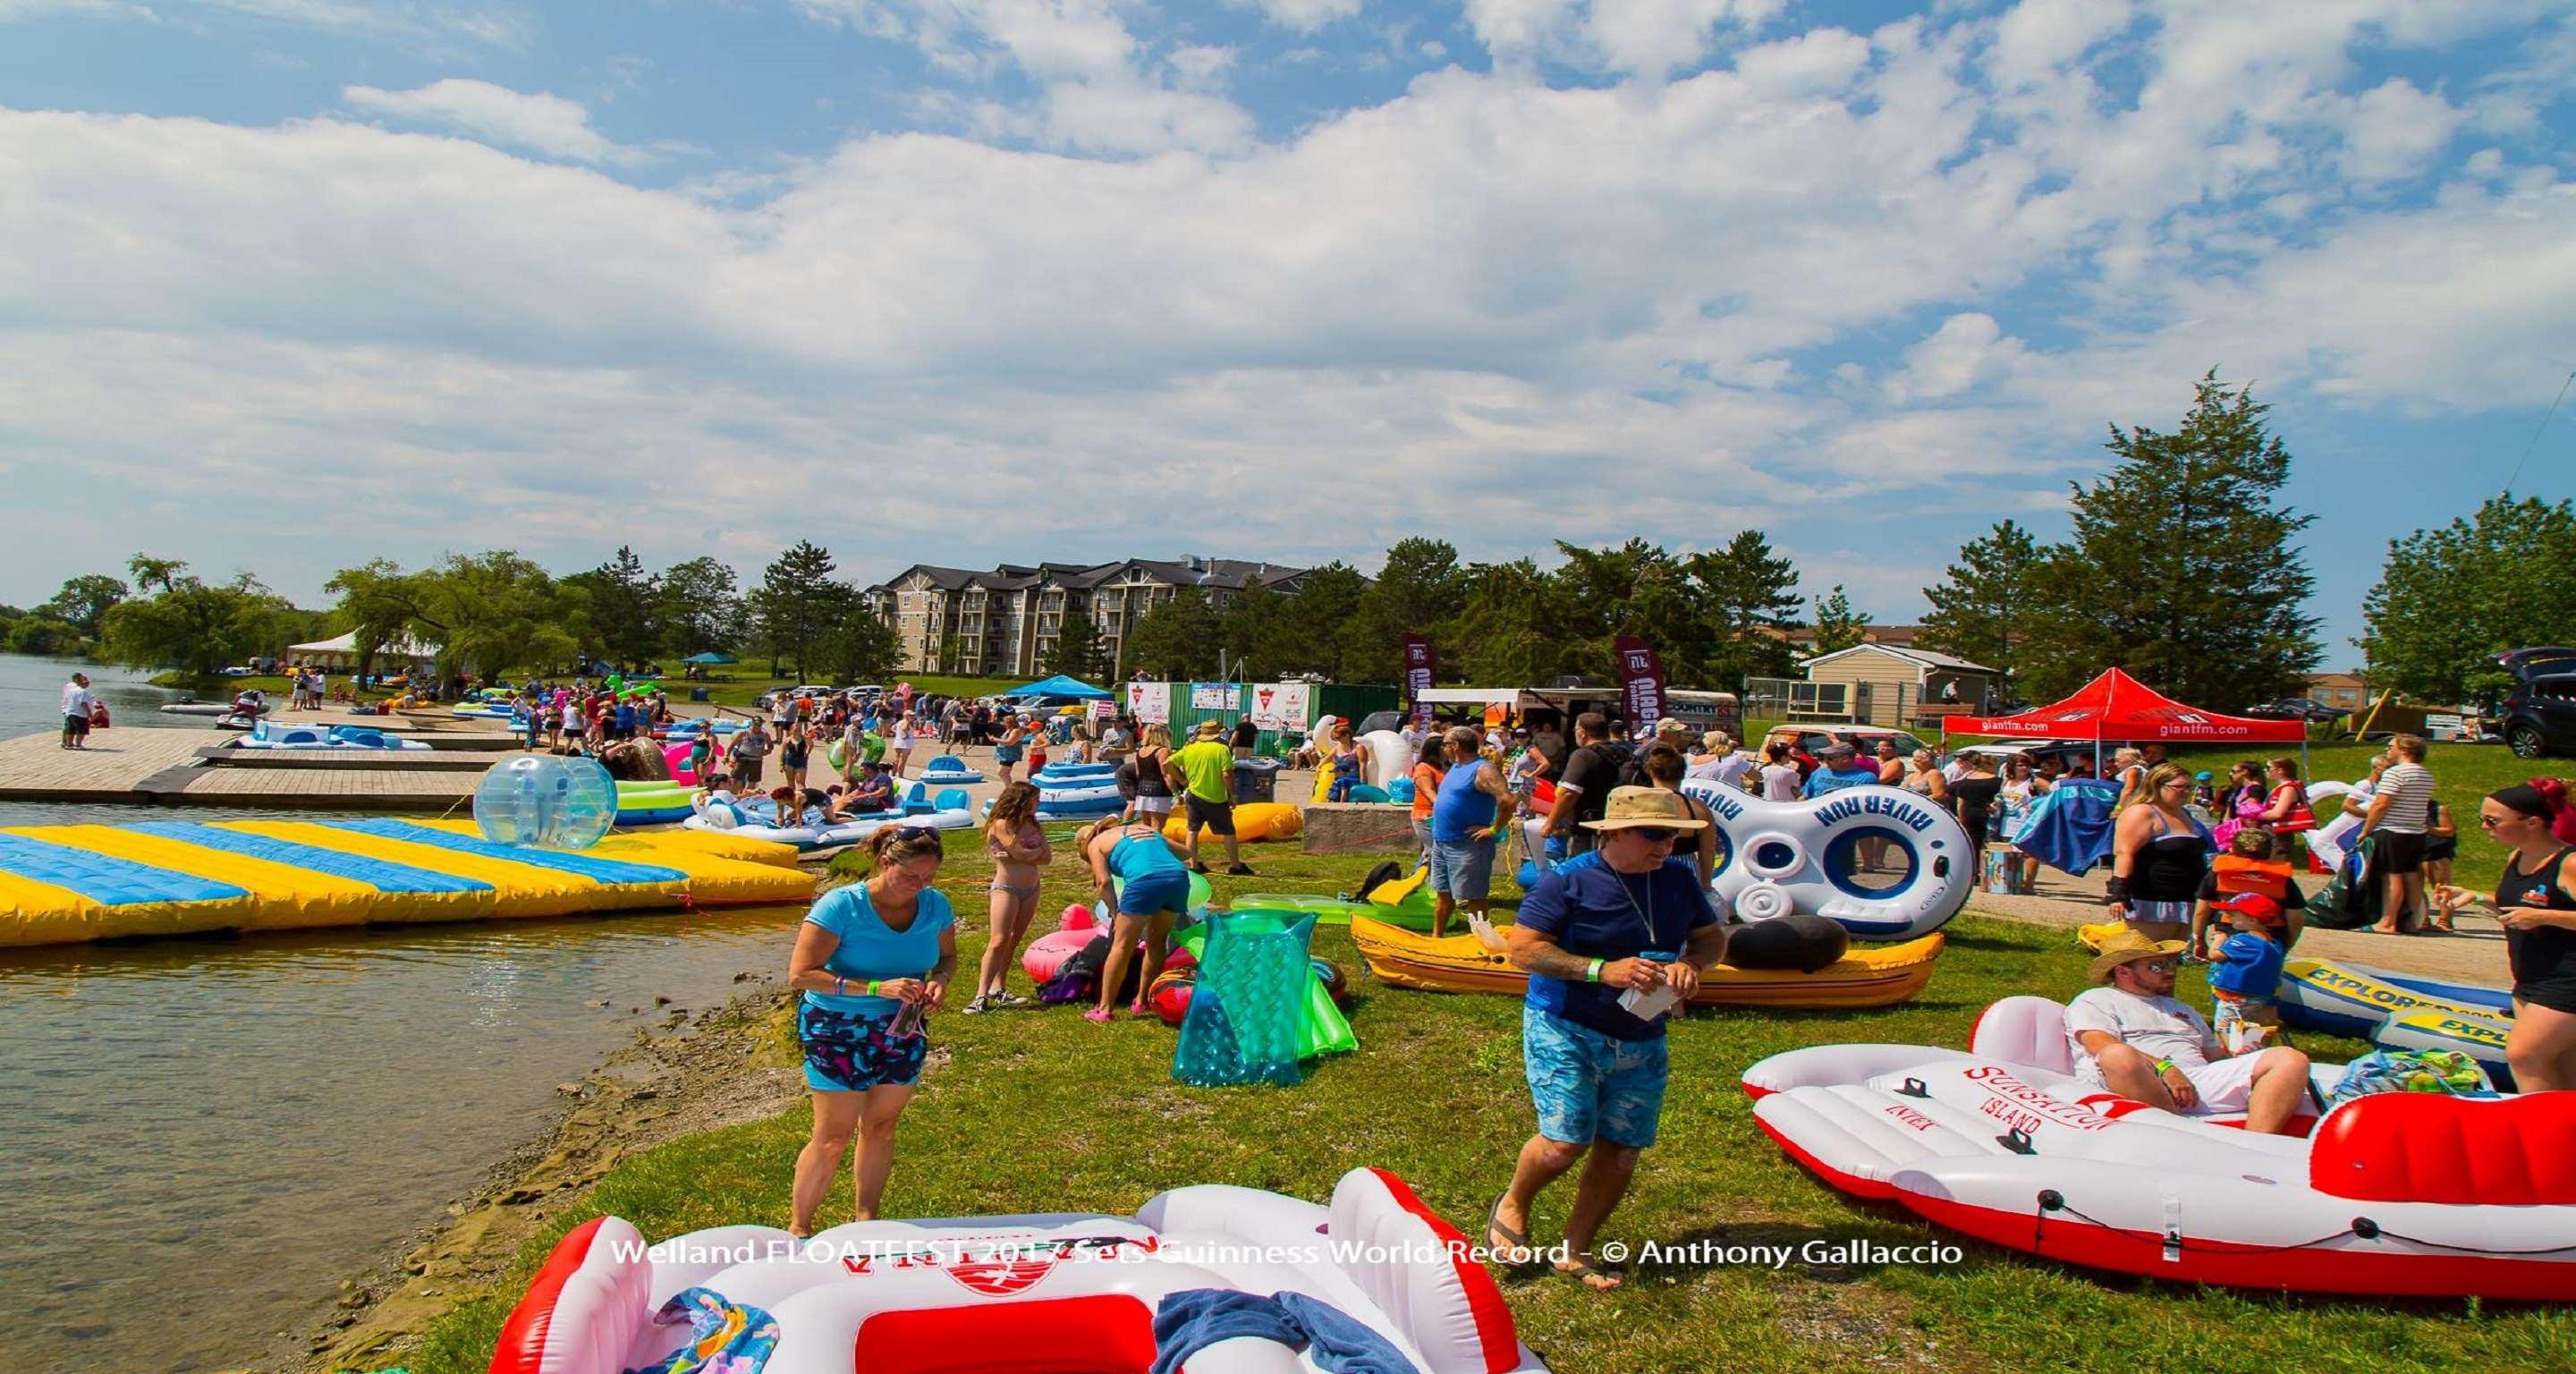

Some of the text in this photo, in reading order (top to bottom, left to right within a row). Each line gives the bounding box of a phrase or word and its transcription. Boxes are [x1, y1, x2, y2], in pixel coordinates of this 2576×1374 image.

[1981, 719, 2048, 732] giantfm.com
[2160, 723, 2248, 737] giantfm.com
[1814, 795, 1935, 832] RIVER RUN
[1885, 1105, 1942, 1132] INTEX
[1979, 1097, 2042, 1134] ISLAND
